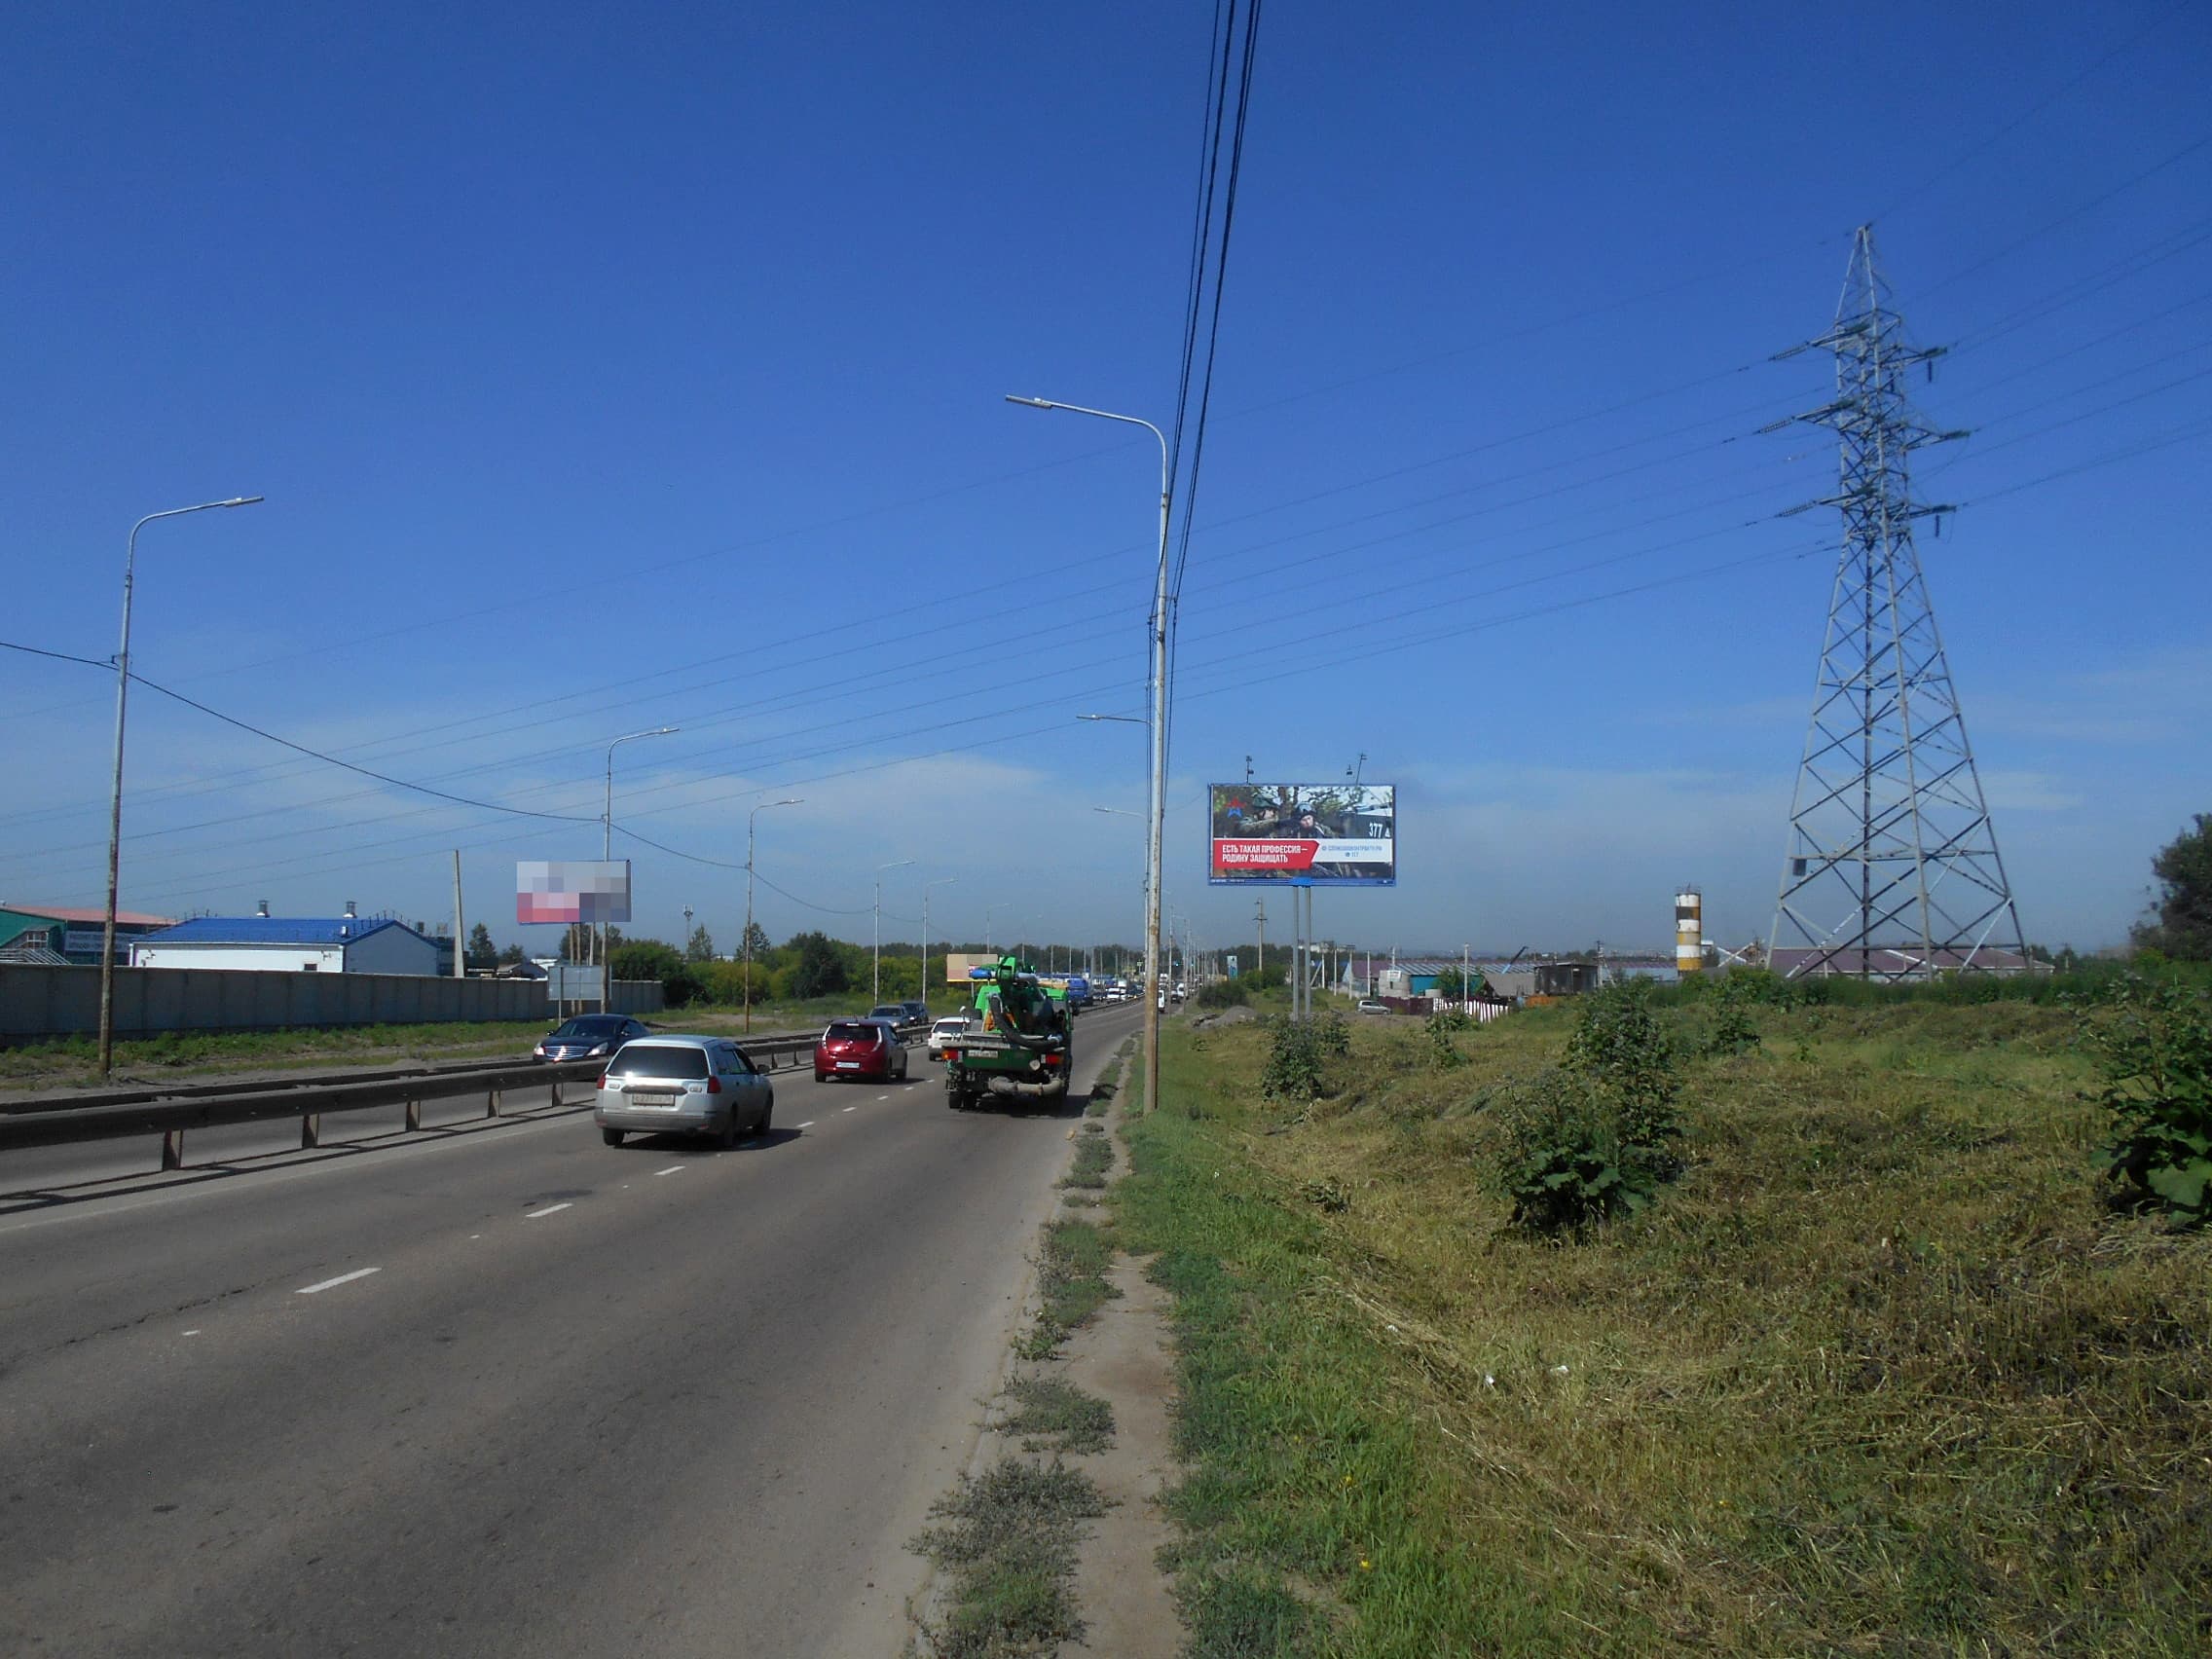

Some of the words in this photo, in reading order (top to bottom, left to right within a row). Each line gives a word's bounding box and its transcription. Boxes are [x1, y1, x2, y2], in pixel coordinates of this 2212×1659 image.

[1369, 822, 1383, 838] 377
[1222, 844, 1238, 853] ЕСТЬ
[1239, 844, 1261, 853] ТАКАЯ
[1222, 854, 1249, 864] РОДИНУ
[1250, 854, 1288, 864] ЗАЩИЩАТЬ
